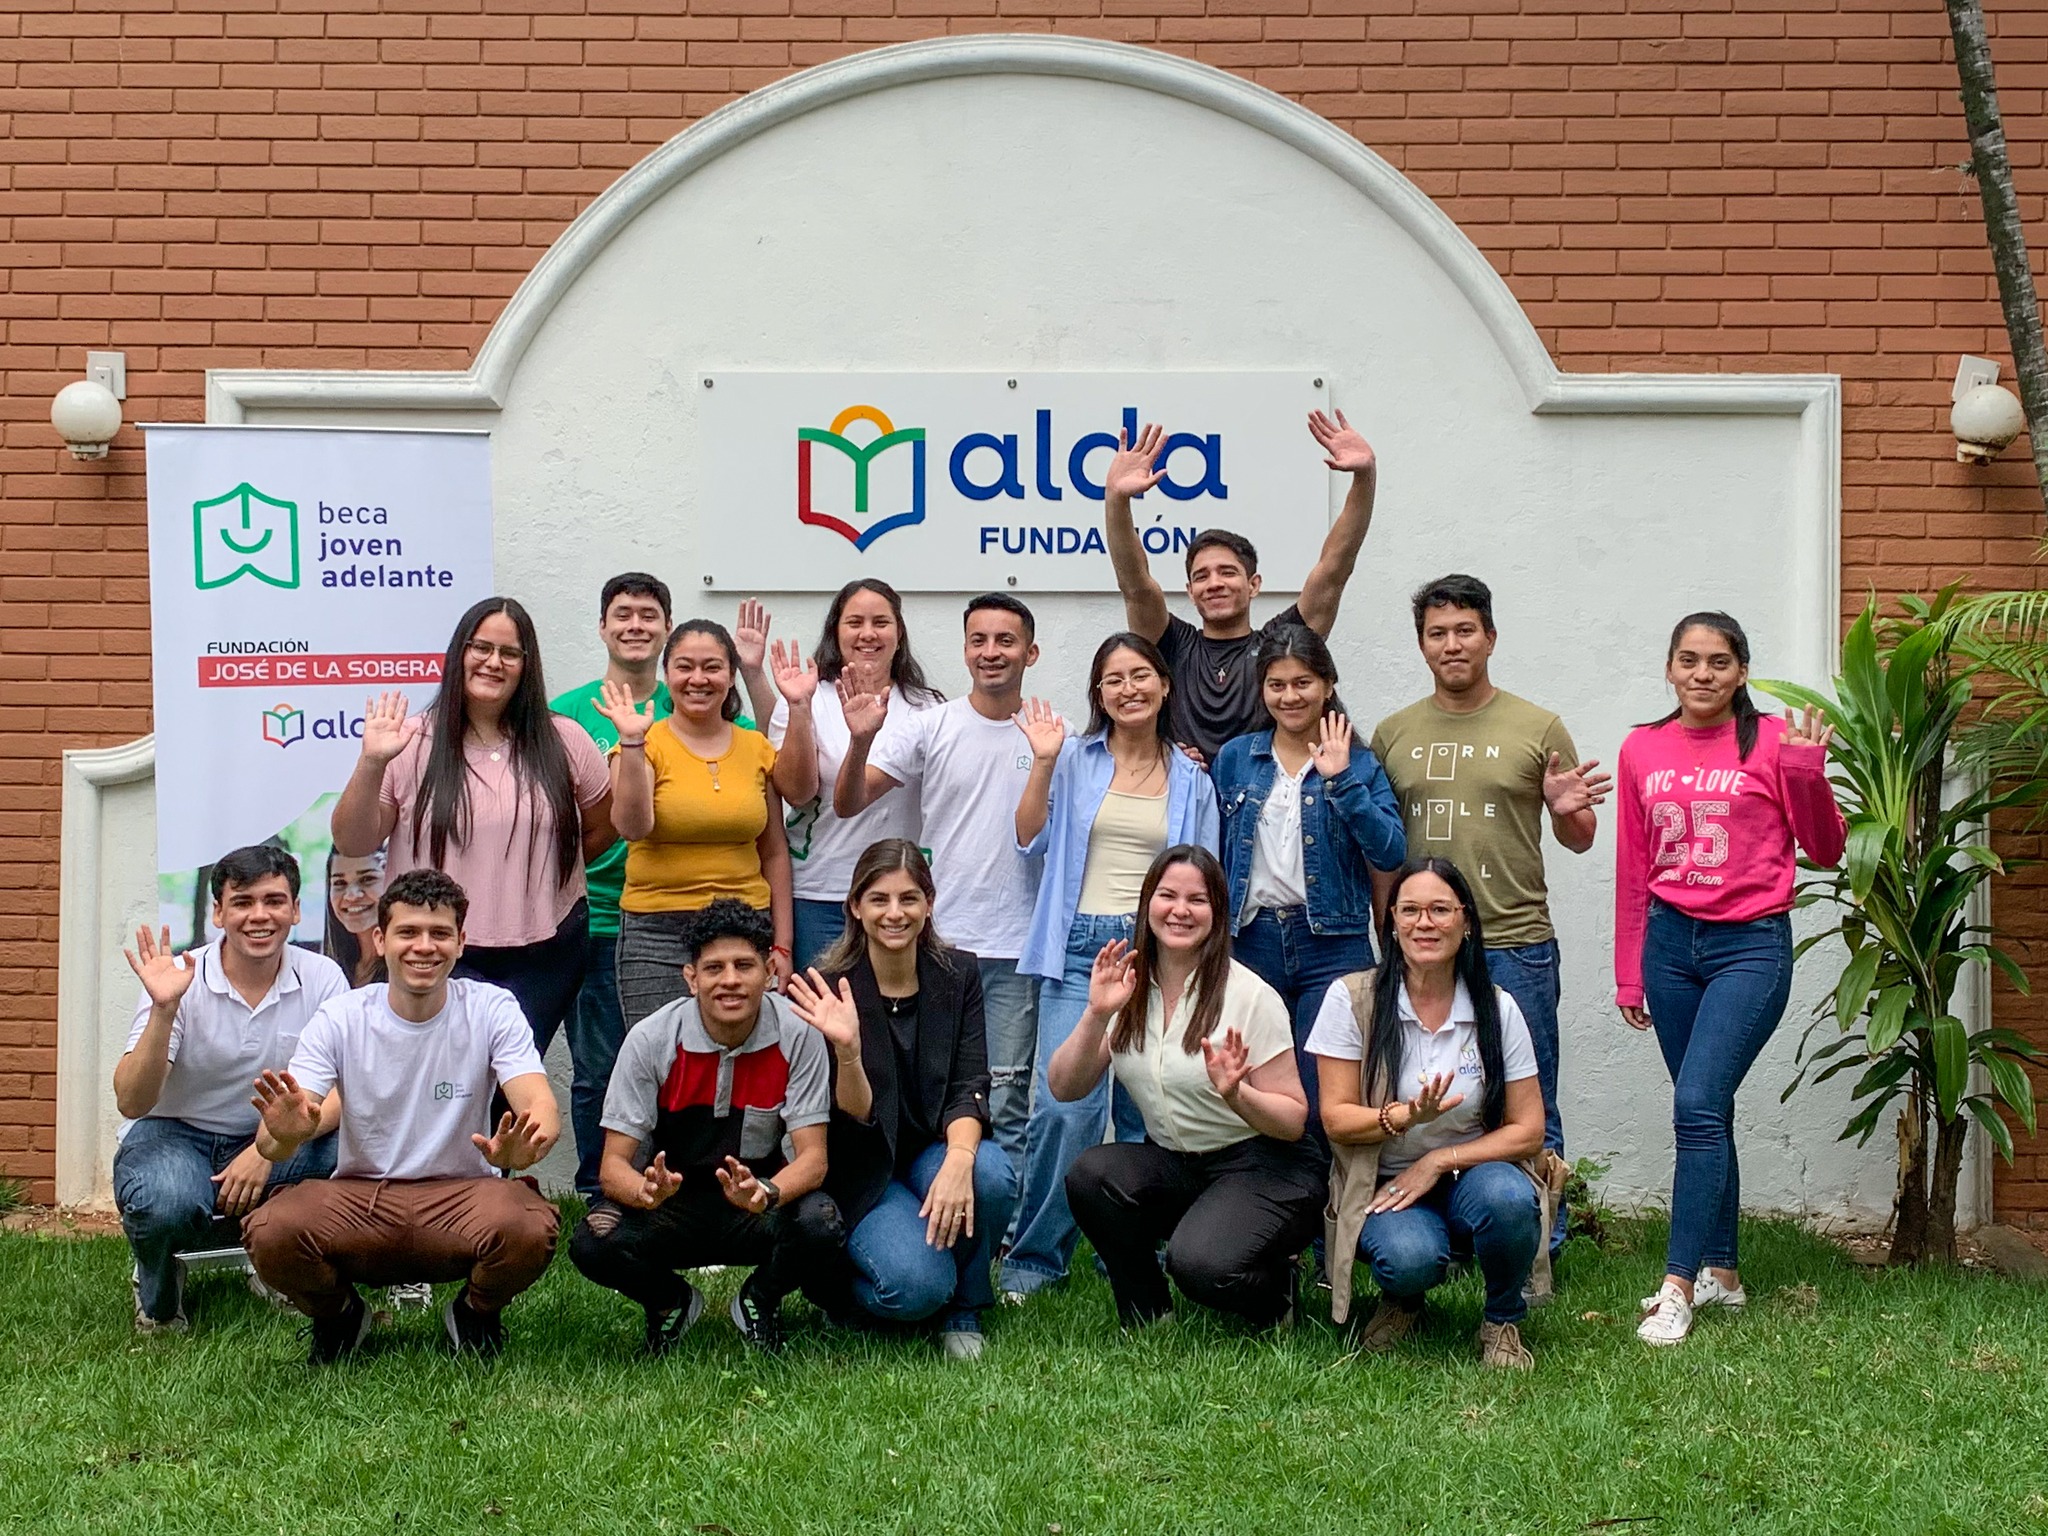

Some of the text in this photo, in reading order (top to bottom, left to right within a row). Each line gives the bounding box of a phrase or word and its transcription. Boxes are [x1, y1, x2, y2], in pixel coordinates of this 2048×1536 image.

[949, 407, 1228, 501] alda
[318, 501, 388, 525] beca
[317, 532, 402, 562] joven
[980, 514, 1197, 554] FUNDAÓN
[321, 564, 454, 588] adelante
[207, 638, 309, 654] FUNDACIÓN
[209, 659, 442, 680] JOSÉ DE LA SOBERA
[1645, 769, 1748, 799] NYC LOVE
[1652, 801, 1730, 867] 25
[1686, 871, 1725, 886] Team
